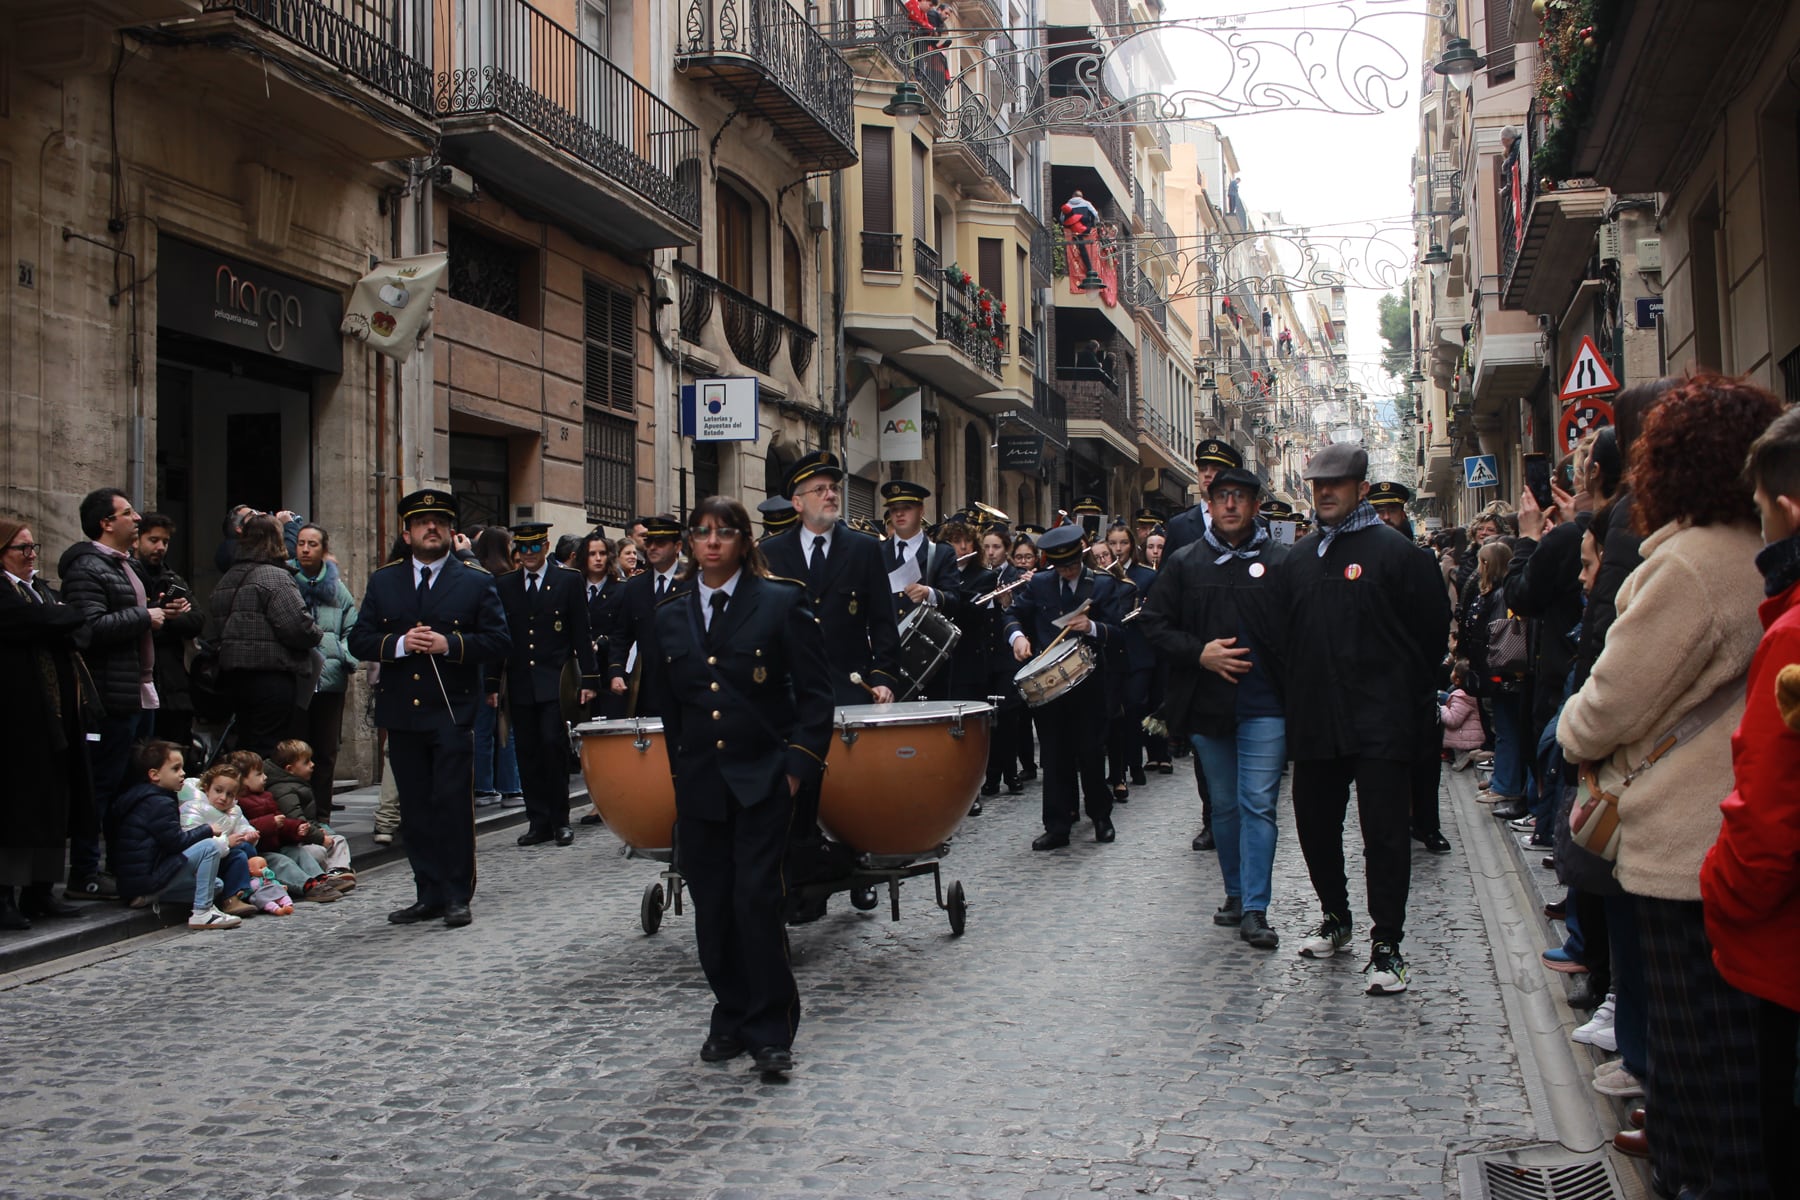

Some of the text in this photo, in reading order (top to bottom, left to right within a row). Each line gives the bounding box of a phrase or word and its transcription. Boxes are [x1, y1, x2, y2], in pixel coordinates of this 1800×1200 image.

[19, 264, 33, 285] 31
[216, 264, 302, 352] marga
[703, 422, 731, 430] Apuestas
[883, 418, 918, 434] ACA
